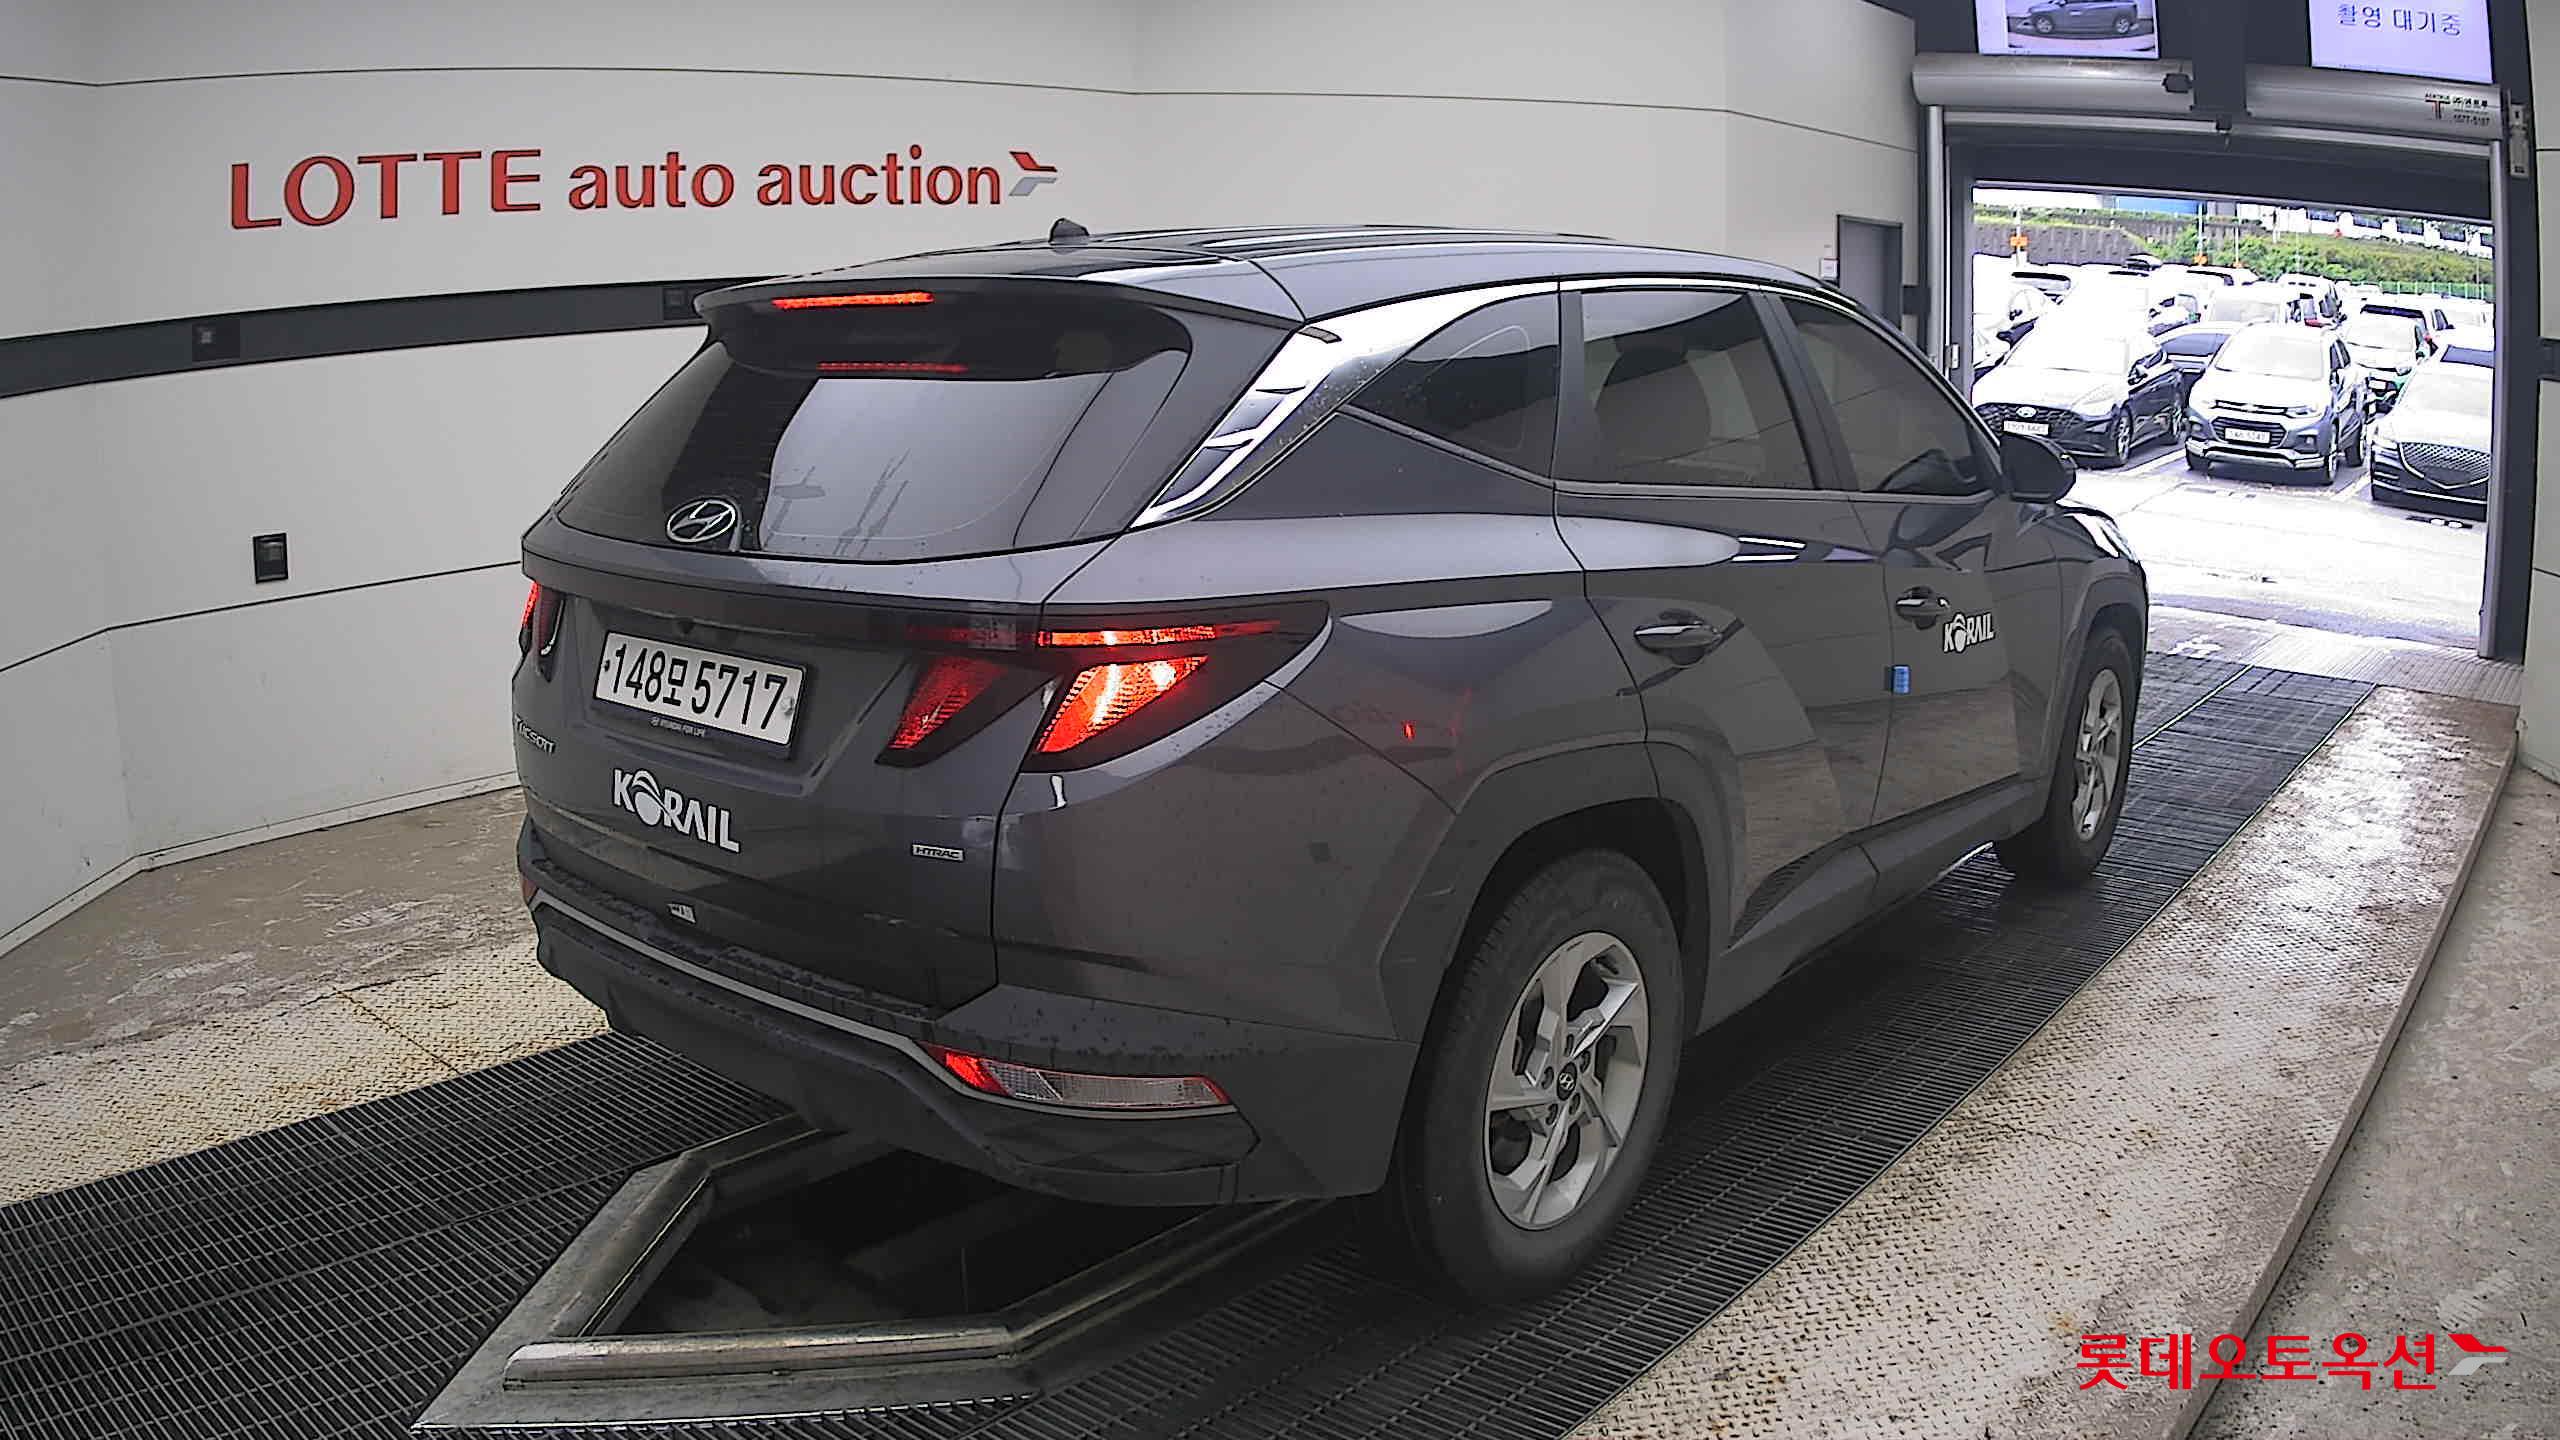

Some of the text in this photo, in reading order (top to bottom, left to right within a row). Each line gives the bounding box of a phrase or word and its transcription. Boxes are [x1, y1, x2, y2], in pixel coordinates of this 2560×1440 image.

[2392, 8, 2461, 36] 대기중
[230, 144, 1001, 230] LOTTE auto auction
[1943, 613, 1995, 652] KORAIL
[614, 769, 740, 853] KORAIL
